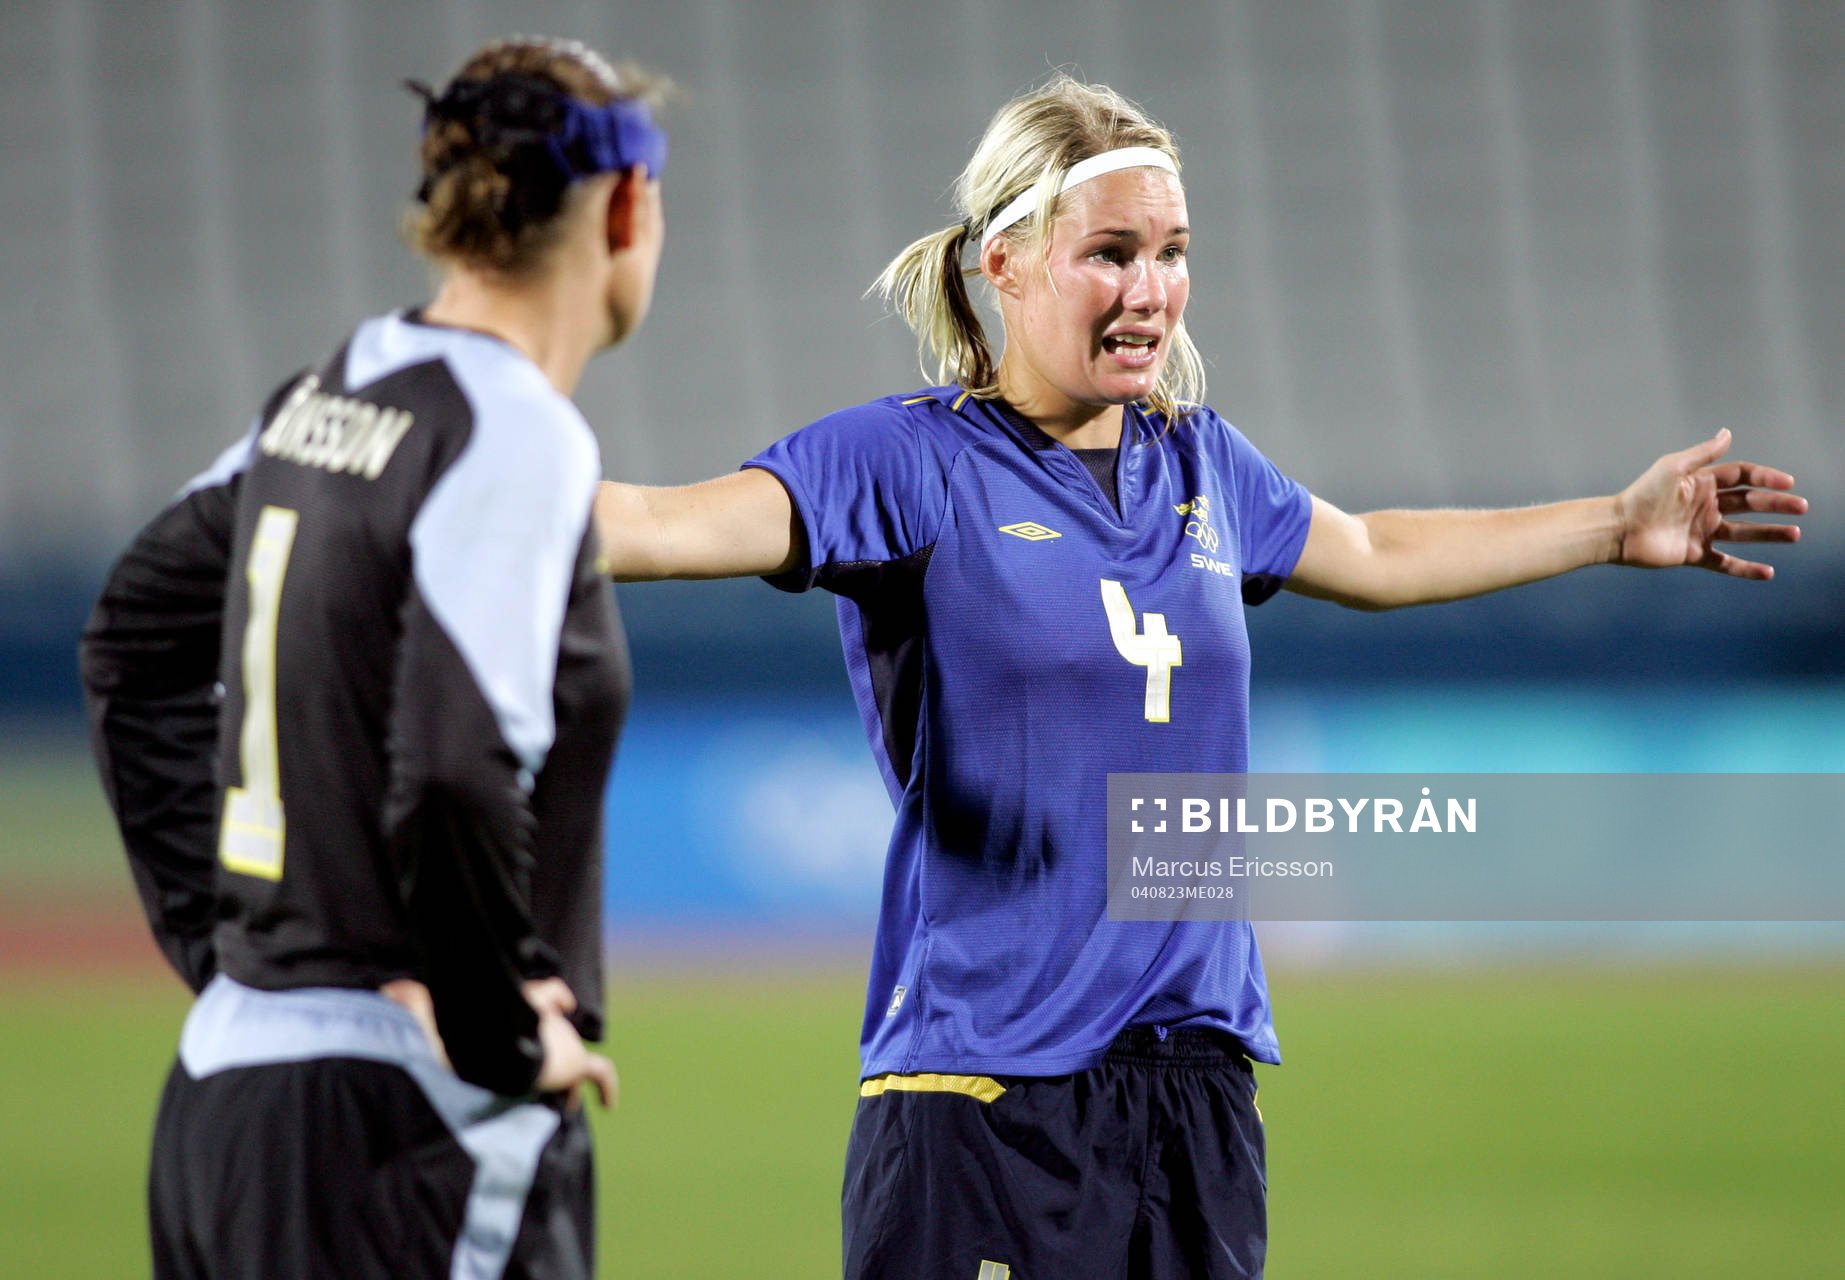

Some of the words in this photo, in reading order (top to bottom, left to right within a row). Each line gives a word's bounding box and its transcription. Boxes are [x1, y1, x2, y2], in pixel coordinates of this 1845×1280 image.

[1191, 553, 1234, 577] SWE
[218, 505, 299, 881] 1
[1100, 578, 1182, 722] 4
